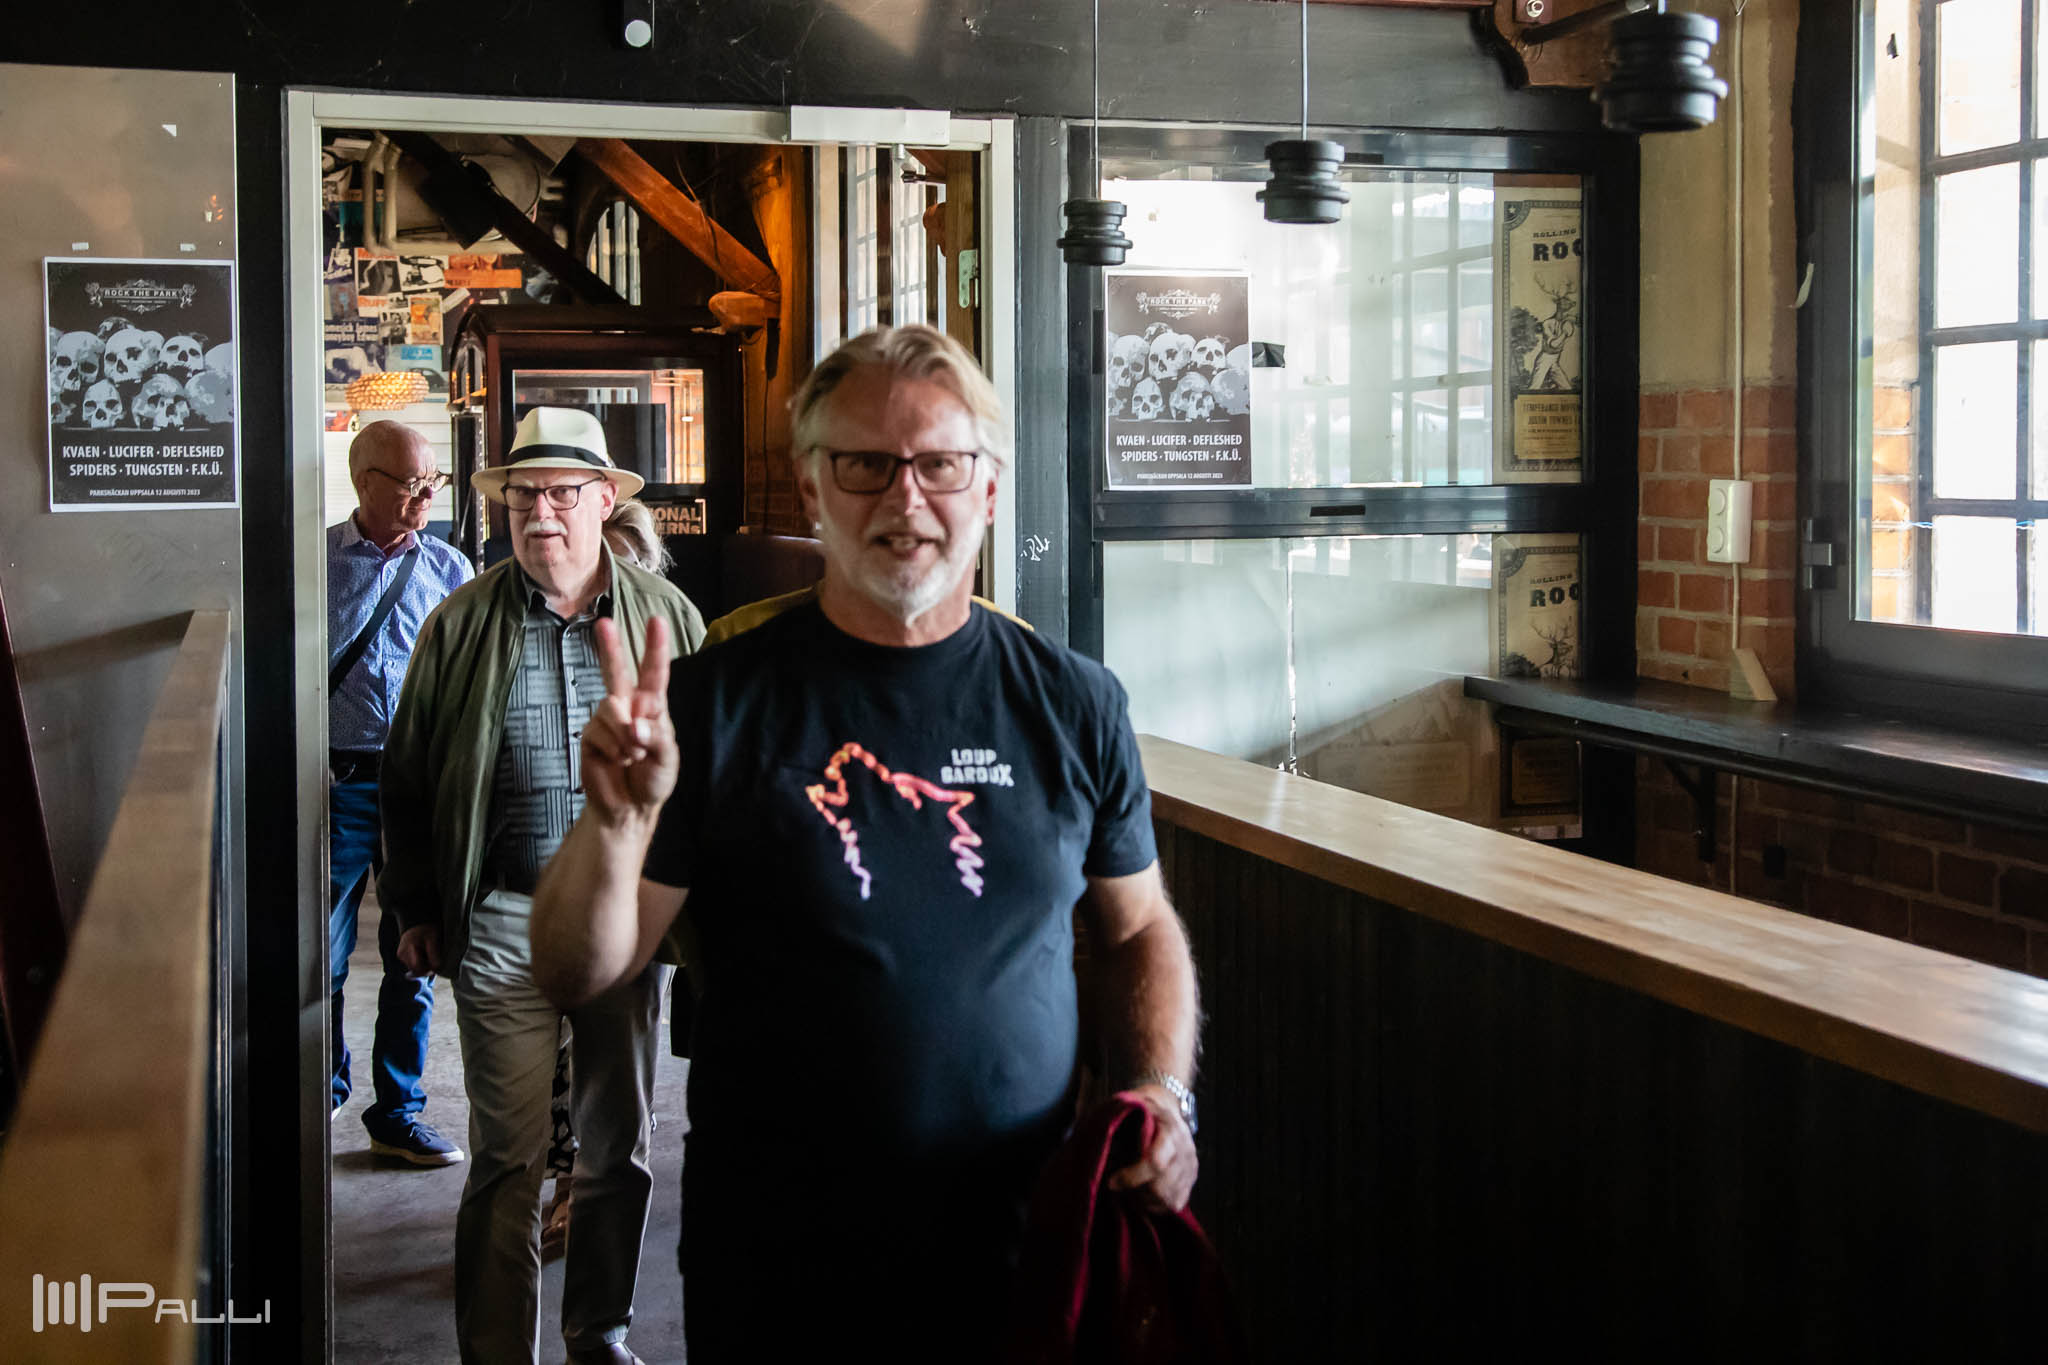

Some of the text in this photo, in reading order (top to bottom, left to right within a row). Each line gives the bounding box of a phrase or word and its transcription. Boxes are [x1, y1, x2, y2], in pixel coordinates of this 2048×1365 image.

[104, 289, 130, 297] ROCK
[133, 289, 150, 297] THE
[1116, 434, 1242, 446] KVAEN LUCIFER DEFLESHED
[62, 445, 225, 458] KVAEN LUCIFER DEFLESHED
[1121, 448, 1242, 462] SPIDERS TUNGSTEN F.K.Ü.
[69, 461, 223, 476] SPIDERS TUNGSTEN F.K.Ü.
[130, 489, 155, 497] UPPSALA
[155, 488, 163, 496] 12
[951, 748, 997, 766] LOUP
